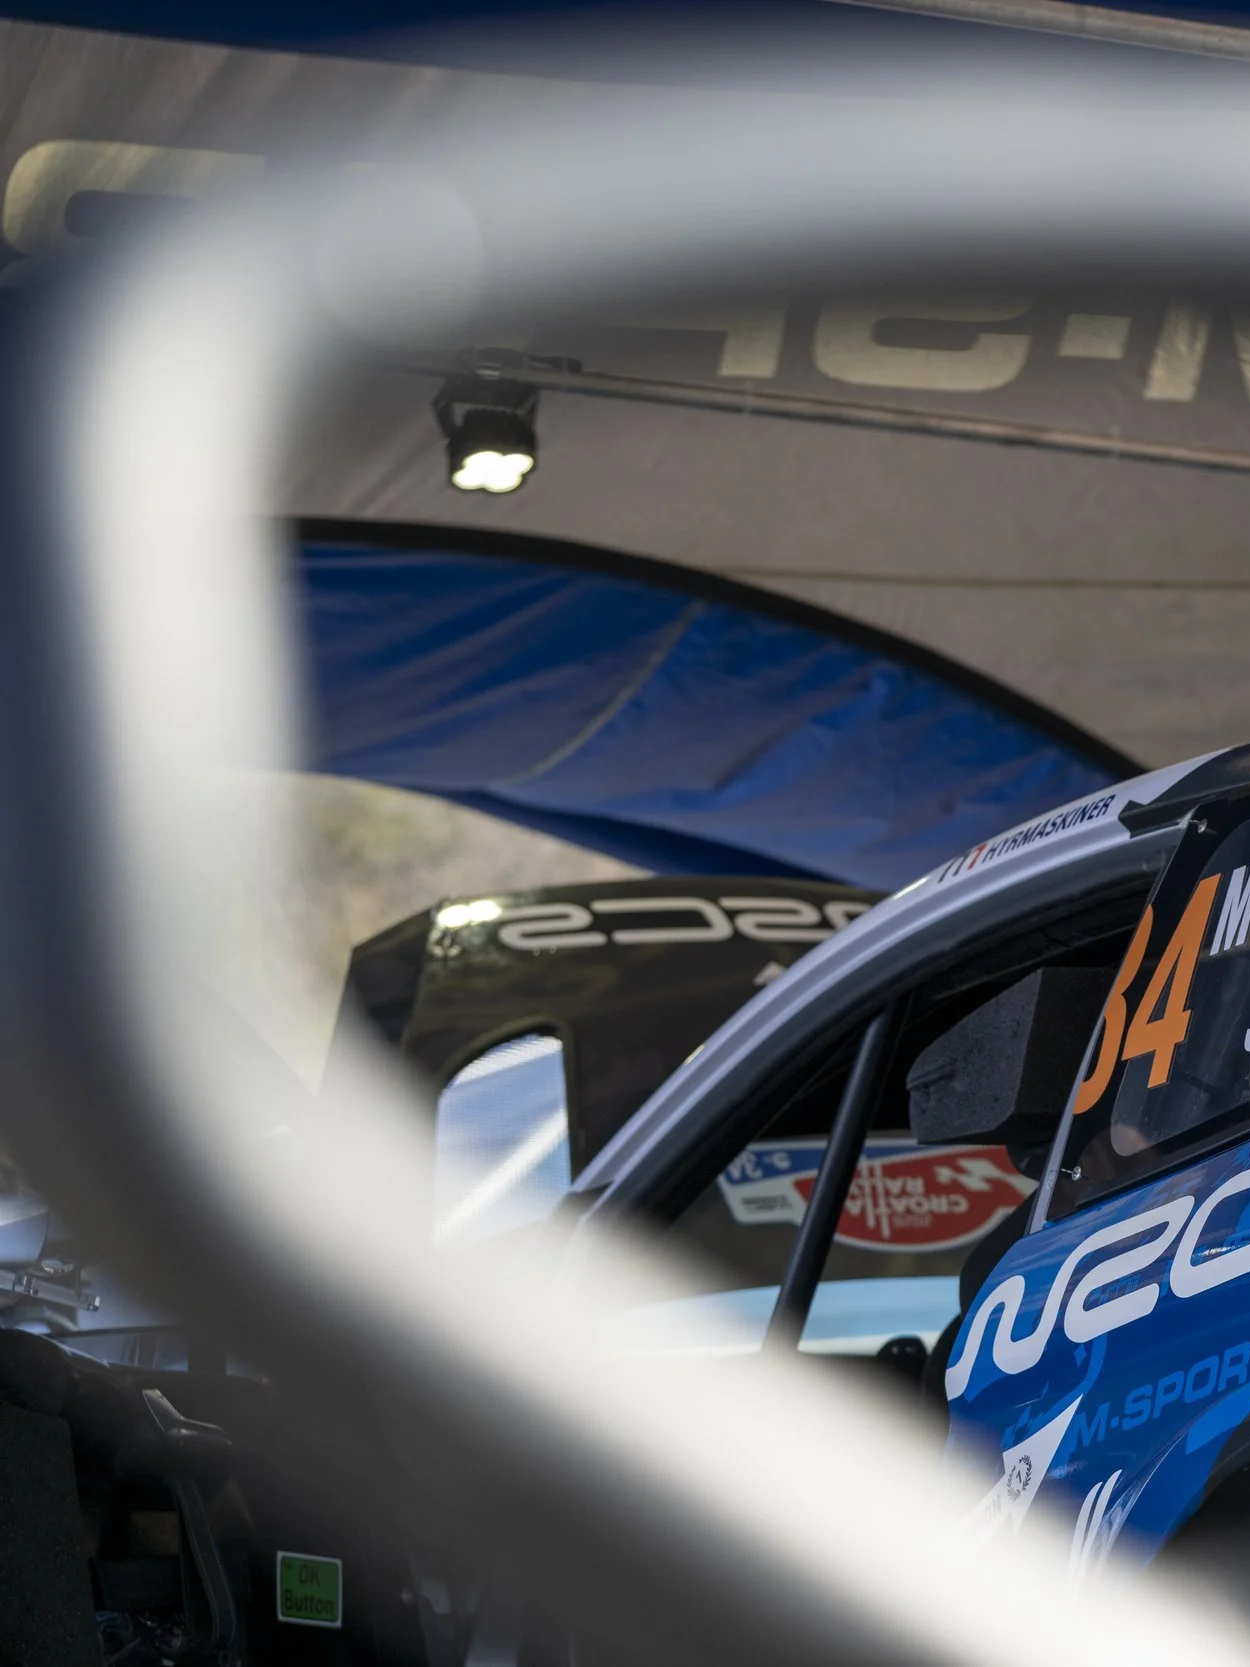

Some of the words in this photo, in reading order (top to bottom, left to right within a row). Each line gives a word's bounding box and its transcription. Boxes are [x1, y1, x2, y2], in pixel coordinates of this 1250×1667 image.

[982, 794, 1117, 864] HYRMASKINER
[298, 1563, 321, 1588] OK
[284, 1588, 334, 1617] Button
